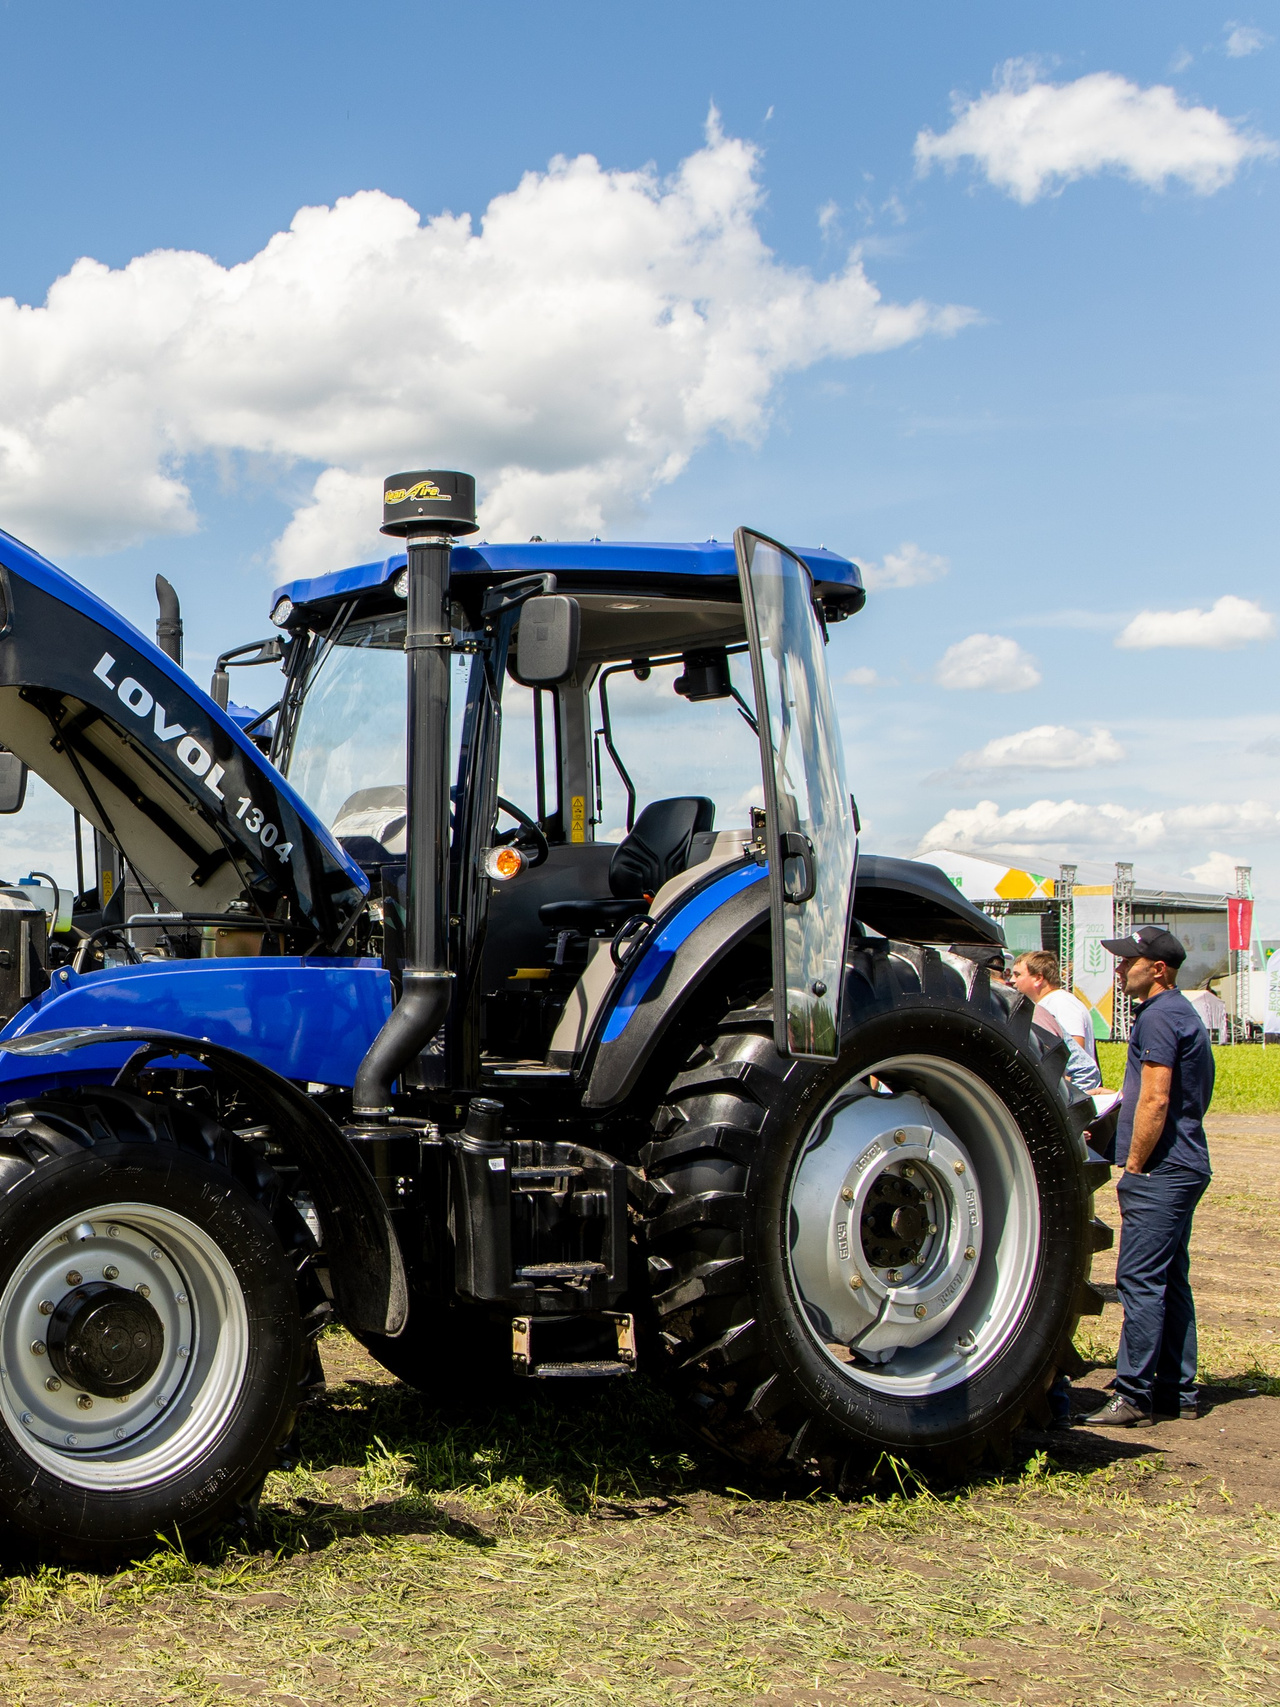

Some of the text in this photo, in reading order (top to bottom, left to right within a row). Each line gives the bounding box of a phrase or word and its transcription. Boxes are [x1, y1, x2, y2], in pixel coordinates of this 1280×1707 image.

[93, 652, 293, 864] LOVOL 1304
[1086, 924, 1105, 932] 2022
[1268, 970, 1279, 1012] EKONIVA
